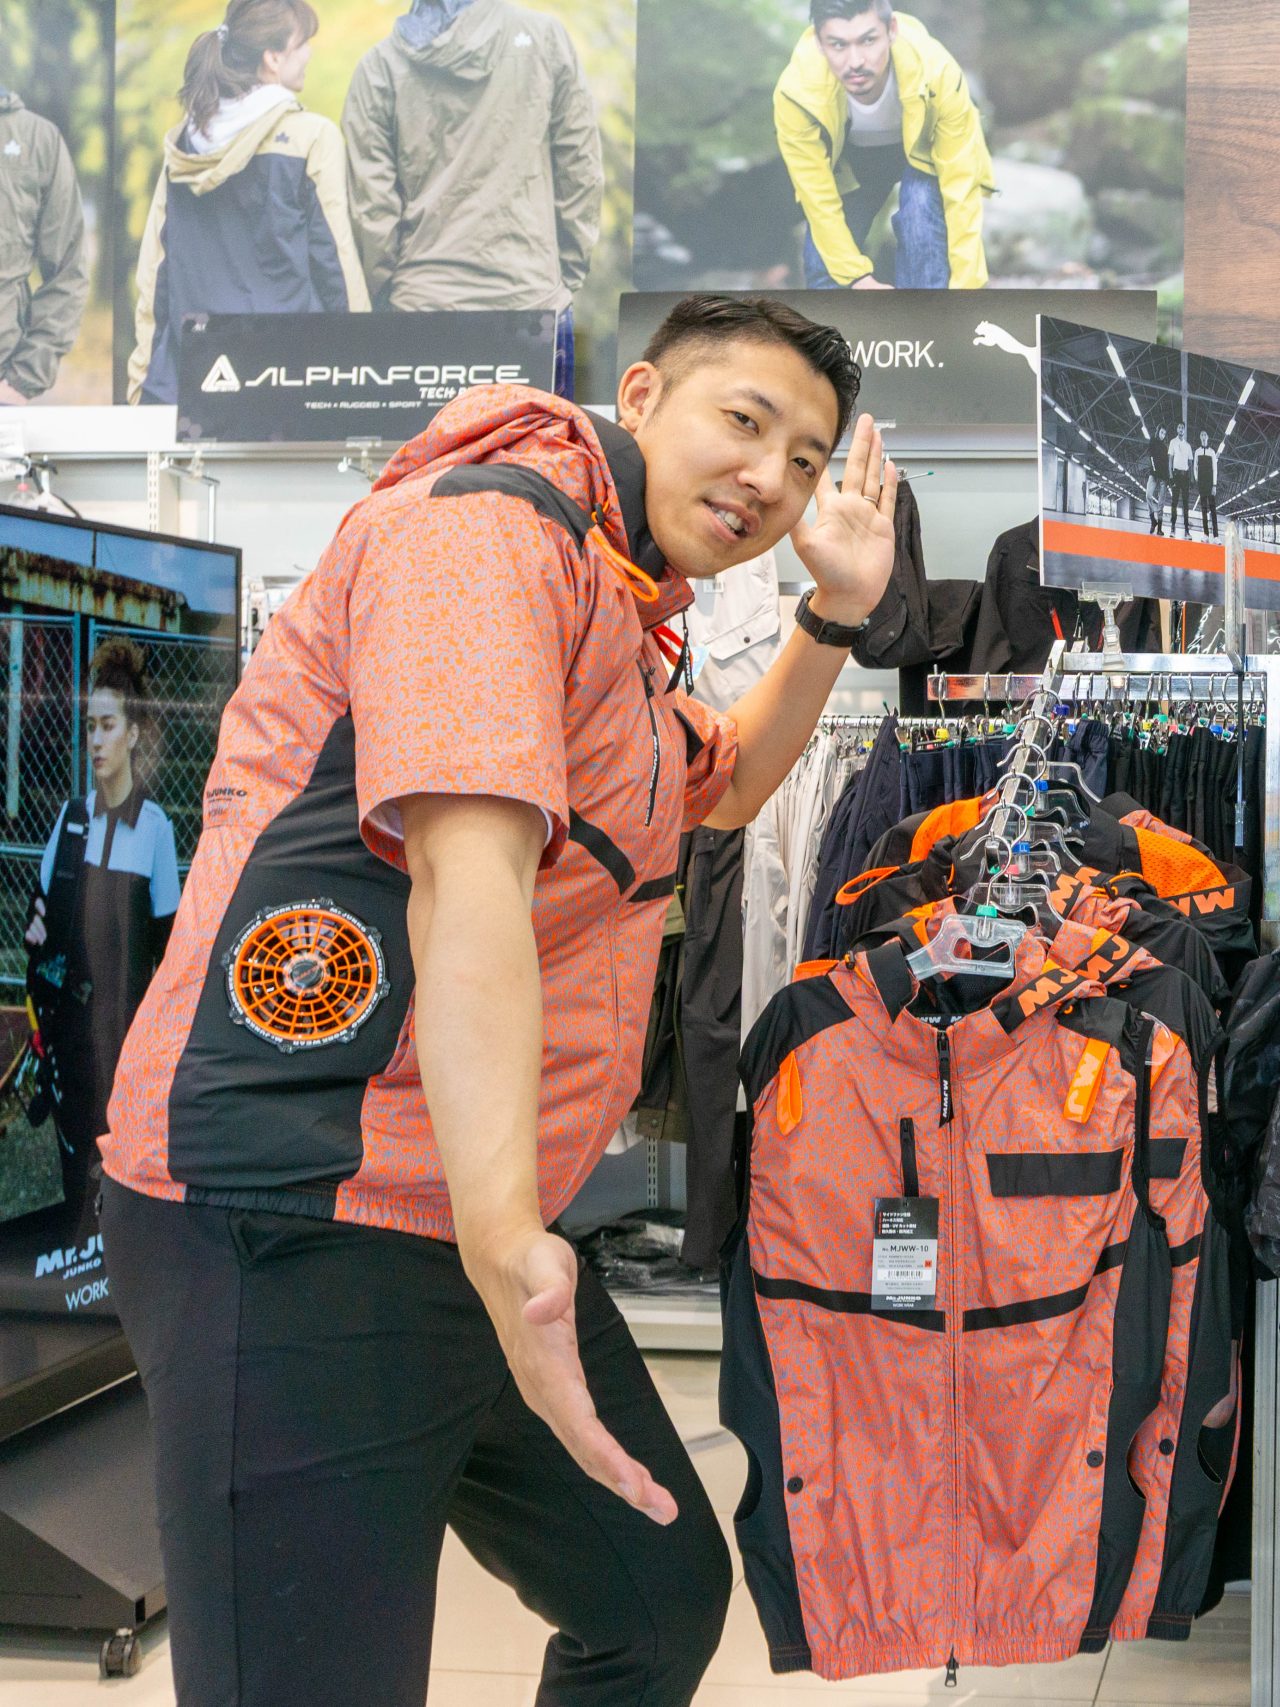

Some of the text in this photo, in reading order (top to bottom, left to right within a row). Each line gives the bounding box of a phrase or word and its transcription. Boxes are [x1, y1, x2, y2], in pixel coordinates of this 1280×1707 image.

[245, 365, 530, 387] ALPHAFORCE
[388, 401, 422, 409] SPORT
[890, 1245, 929, 1253] MJWW-10
[62, 1257, 102, 1280] JUNKO
[65, 1276, 110, 1312] WORK
